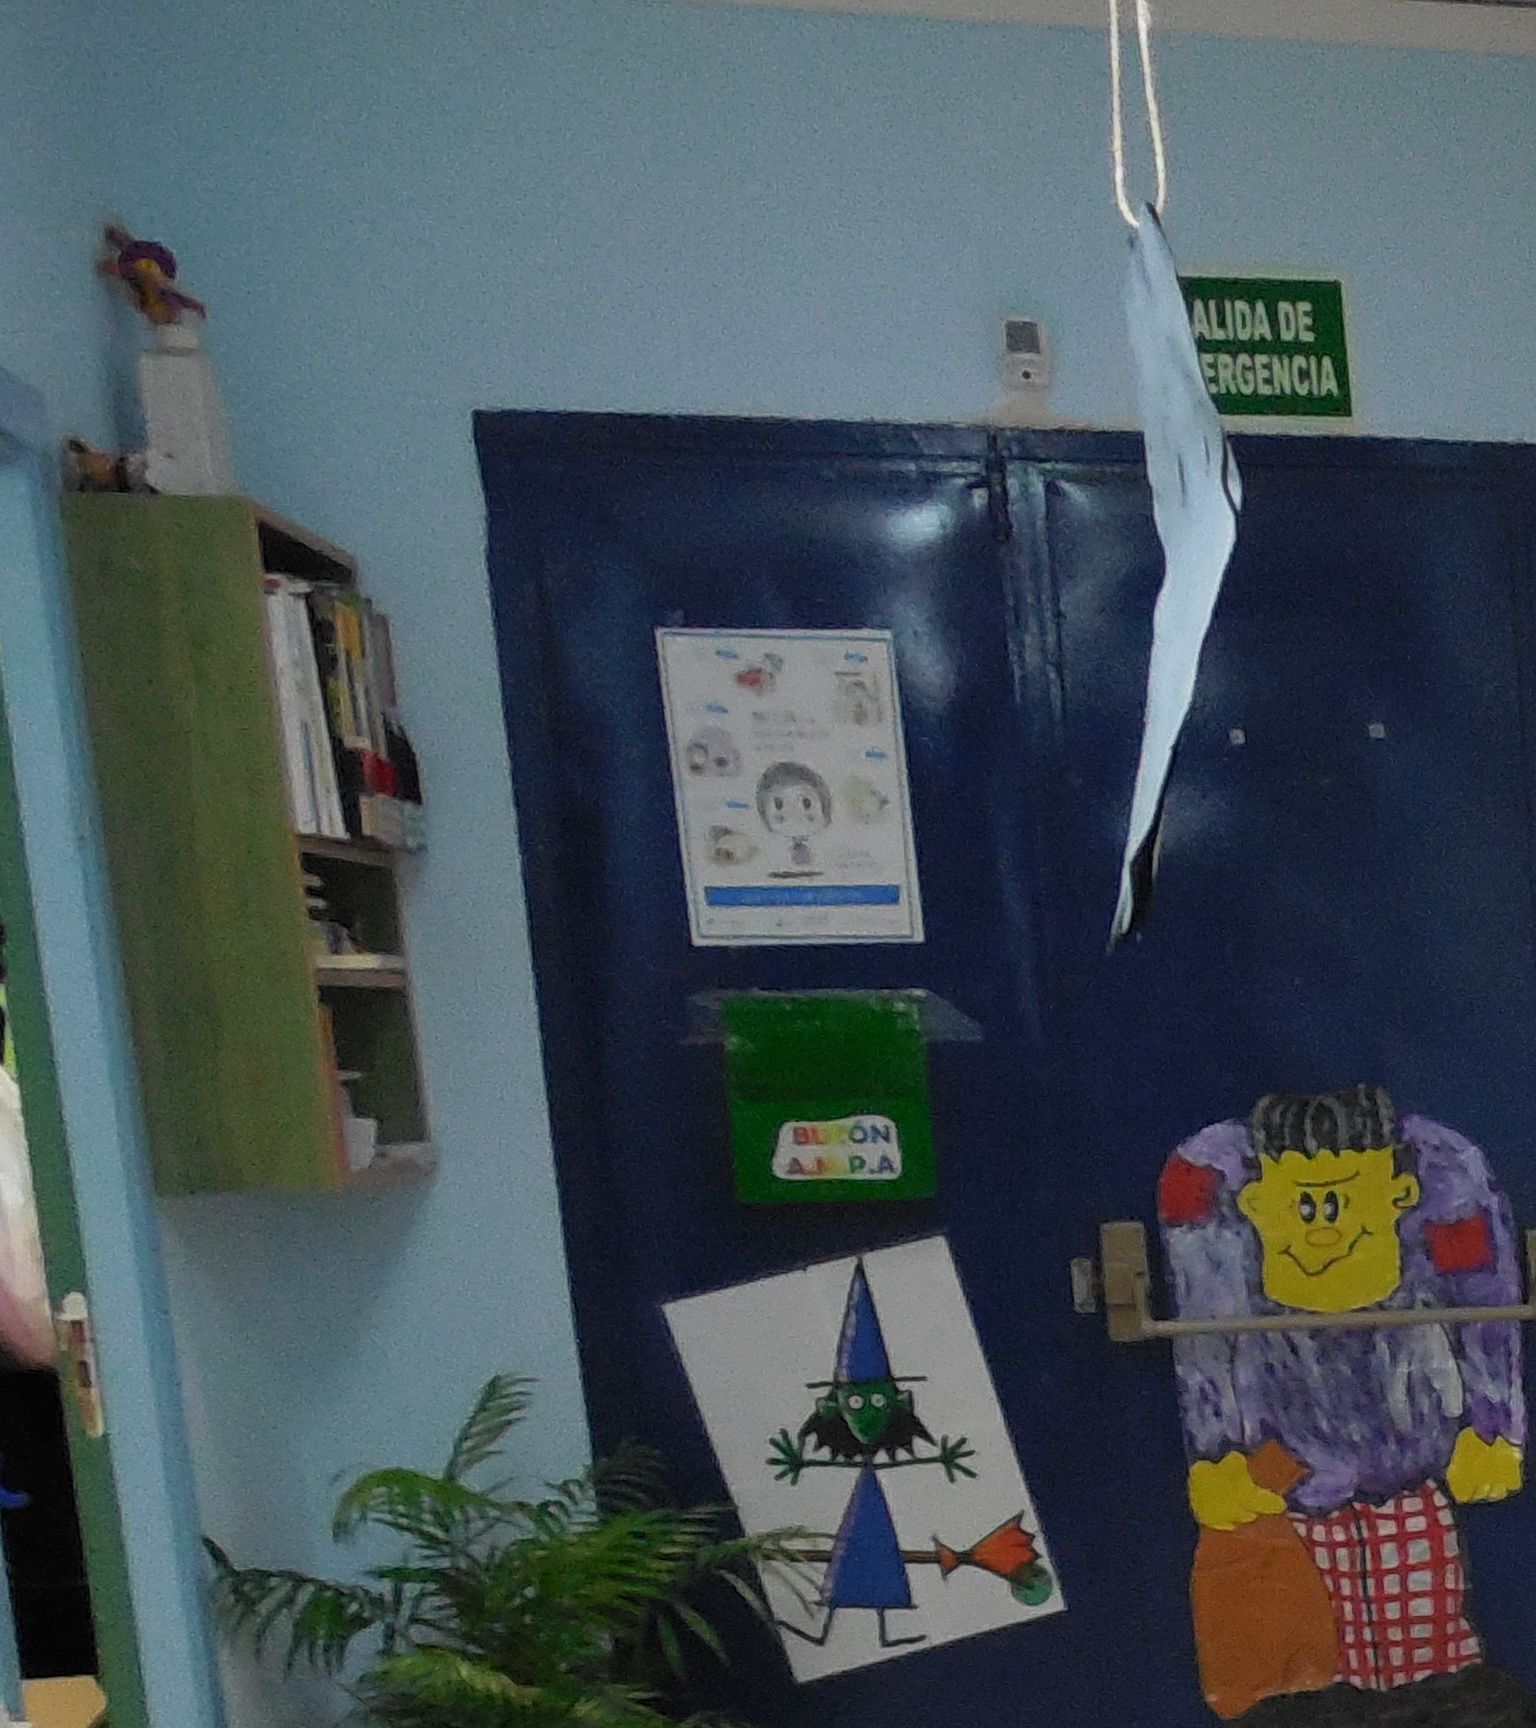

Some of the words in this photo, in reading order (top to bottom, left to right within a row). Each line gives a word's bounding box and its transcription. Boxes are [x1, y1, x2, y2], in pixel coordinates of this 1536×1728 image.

[1191, 298, 1273, 342] ALIDA
[1276, 300, 1316, 343] DE
[1200, 353, 1340, 397] ERGENCIA
